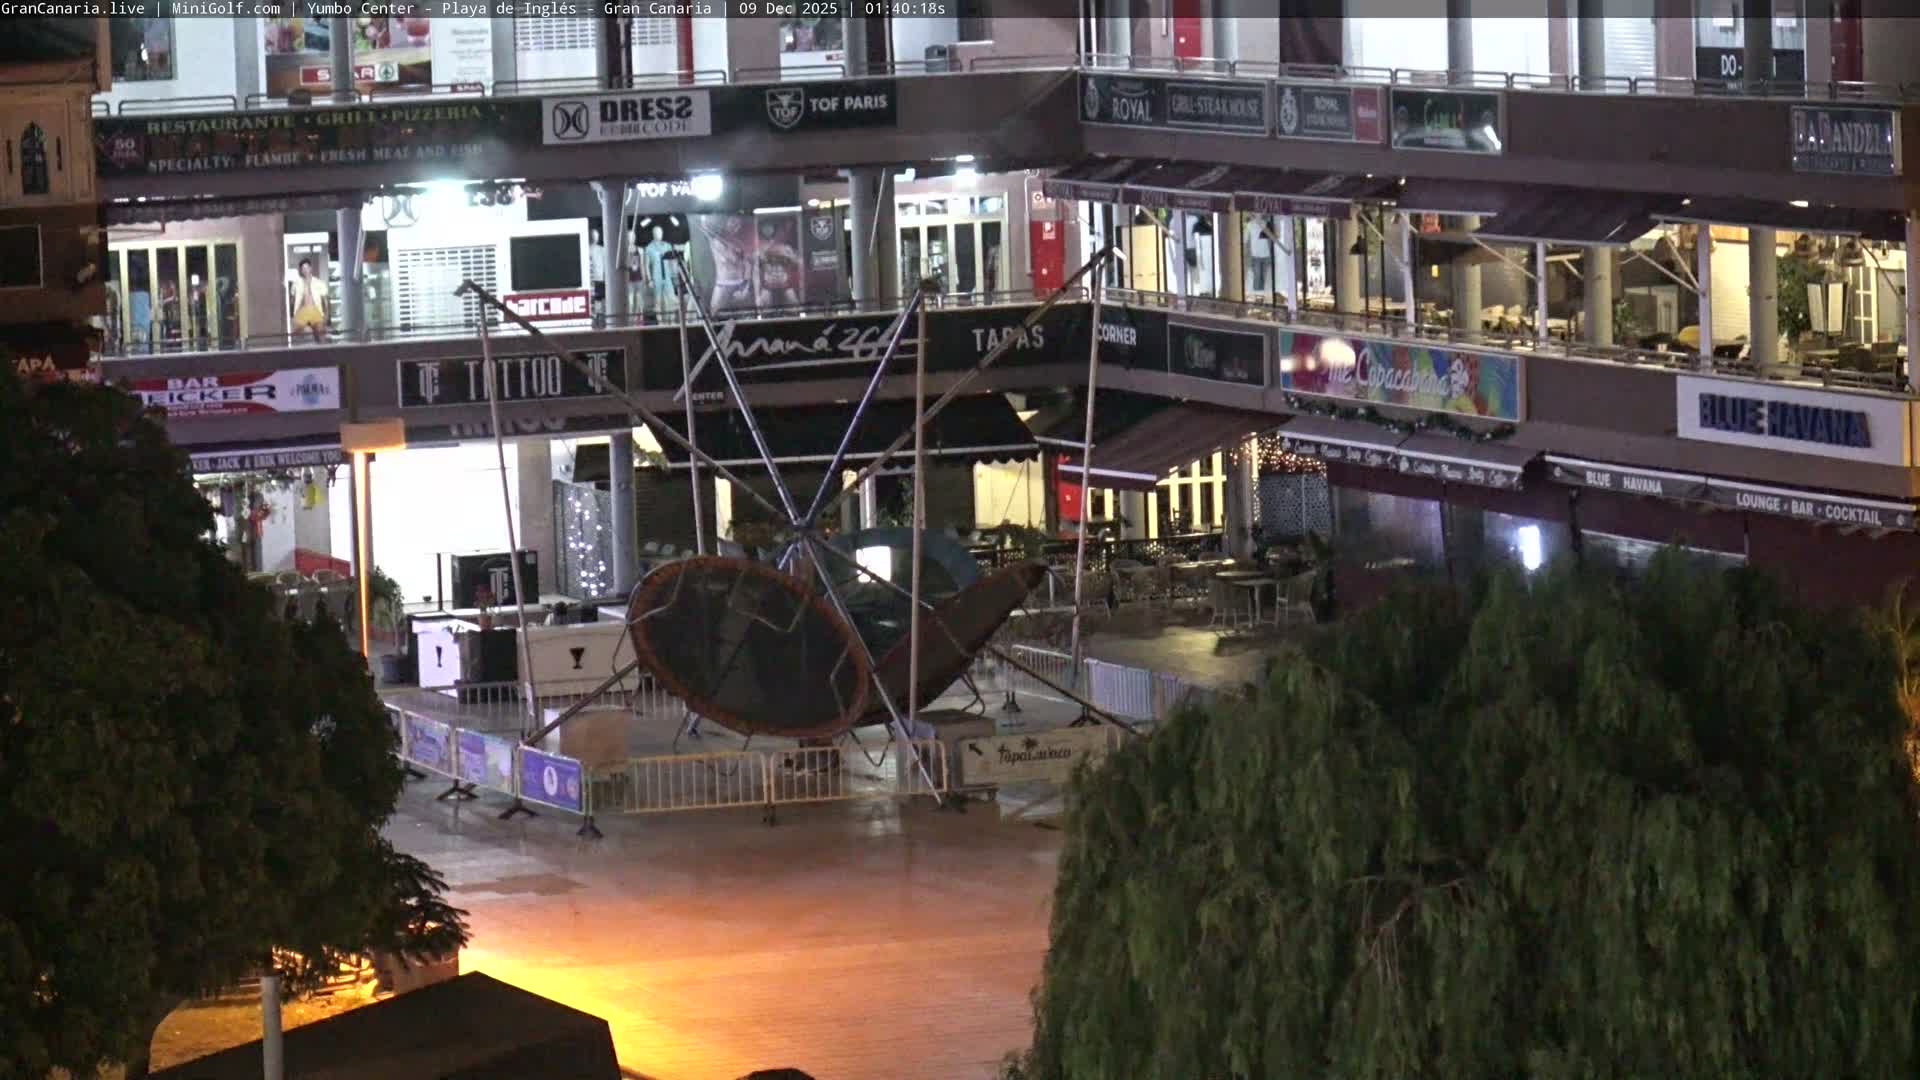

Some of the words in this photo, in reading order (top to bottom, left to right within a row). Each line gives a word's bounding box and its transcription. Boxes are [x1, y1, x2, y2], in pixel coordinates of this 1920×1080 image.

[316, 67, 375, 81] SR
[774, 106, 798, 118] TOF
[809, 97, 839, 112] TOF
[844, 94, 888, 110] PARIS
[1111, 97, 1152, 121] ROYAL
[147, 114, 296, 135] RESTAURANTE
[391, 105, 482, 121] PIZZERIA
[167, 376, 219, 390] BAR
[464, 357, 561, 400] TATTOO
[1699, 393, 1765, 435] BLUE
[1767, 401, 1871, 448] HAVANA
[1586, 470, 1611, 487] BLUE
[1623, 477, 1663, 494] HAVANA
[1736, 492, 1780, 513] LOUNGE
[1791, 500, 1813, 517] BAR
[1825, 504, 1882, 526] COCKTAIL
